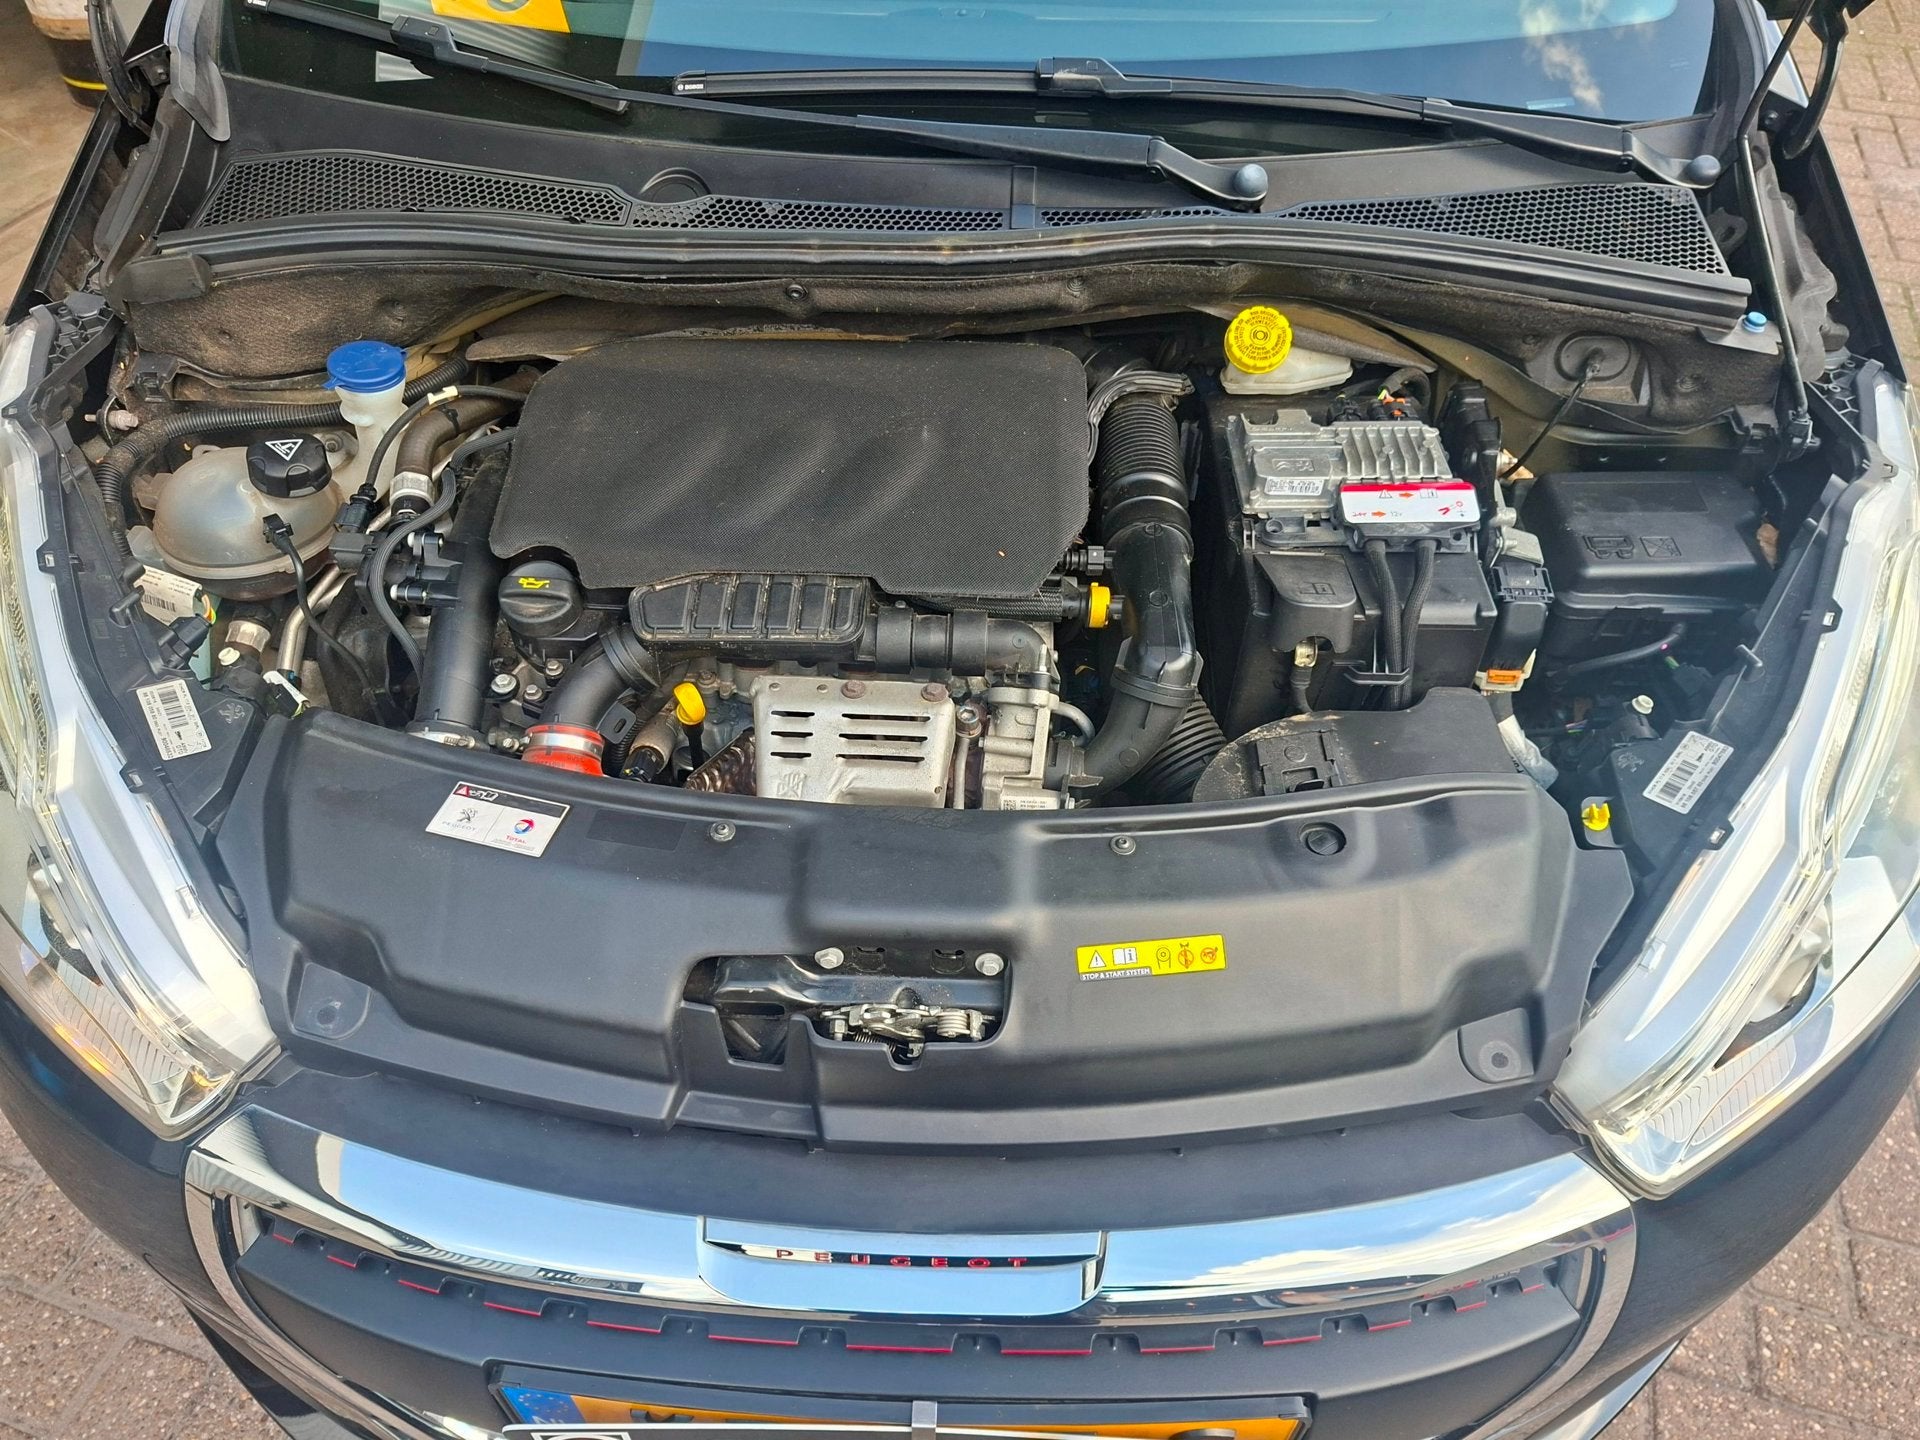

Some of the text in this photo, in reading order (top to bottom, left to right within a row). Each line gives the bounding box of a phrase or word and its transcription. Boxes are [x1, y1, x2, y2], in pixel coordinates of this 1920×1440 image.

[442, 821, 476, 832] PEUGEOT
[506, 835, 527, 844] TOTAL
[1082, 973, 1099, 981] STOP
[1106, 970, 1125, 978] START
[1126, 967, 1150, 976] SYSTEM
[776, 1248, 1028, 1268] PEUGEOT
